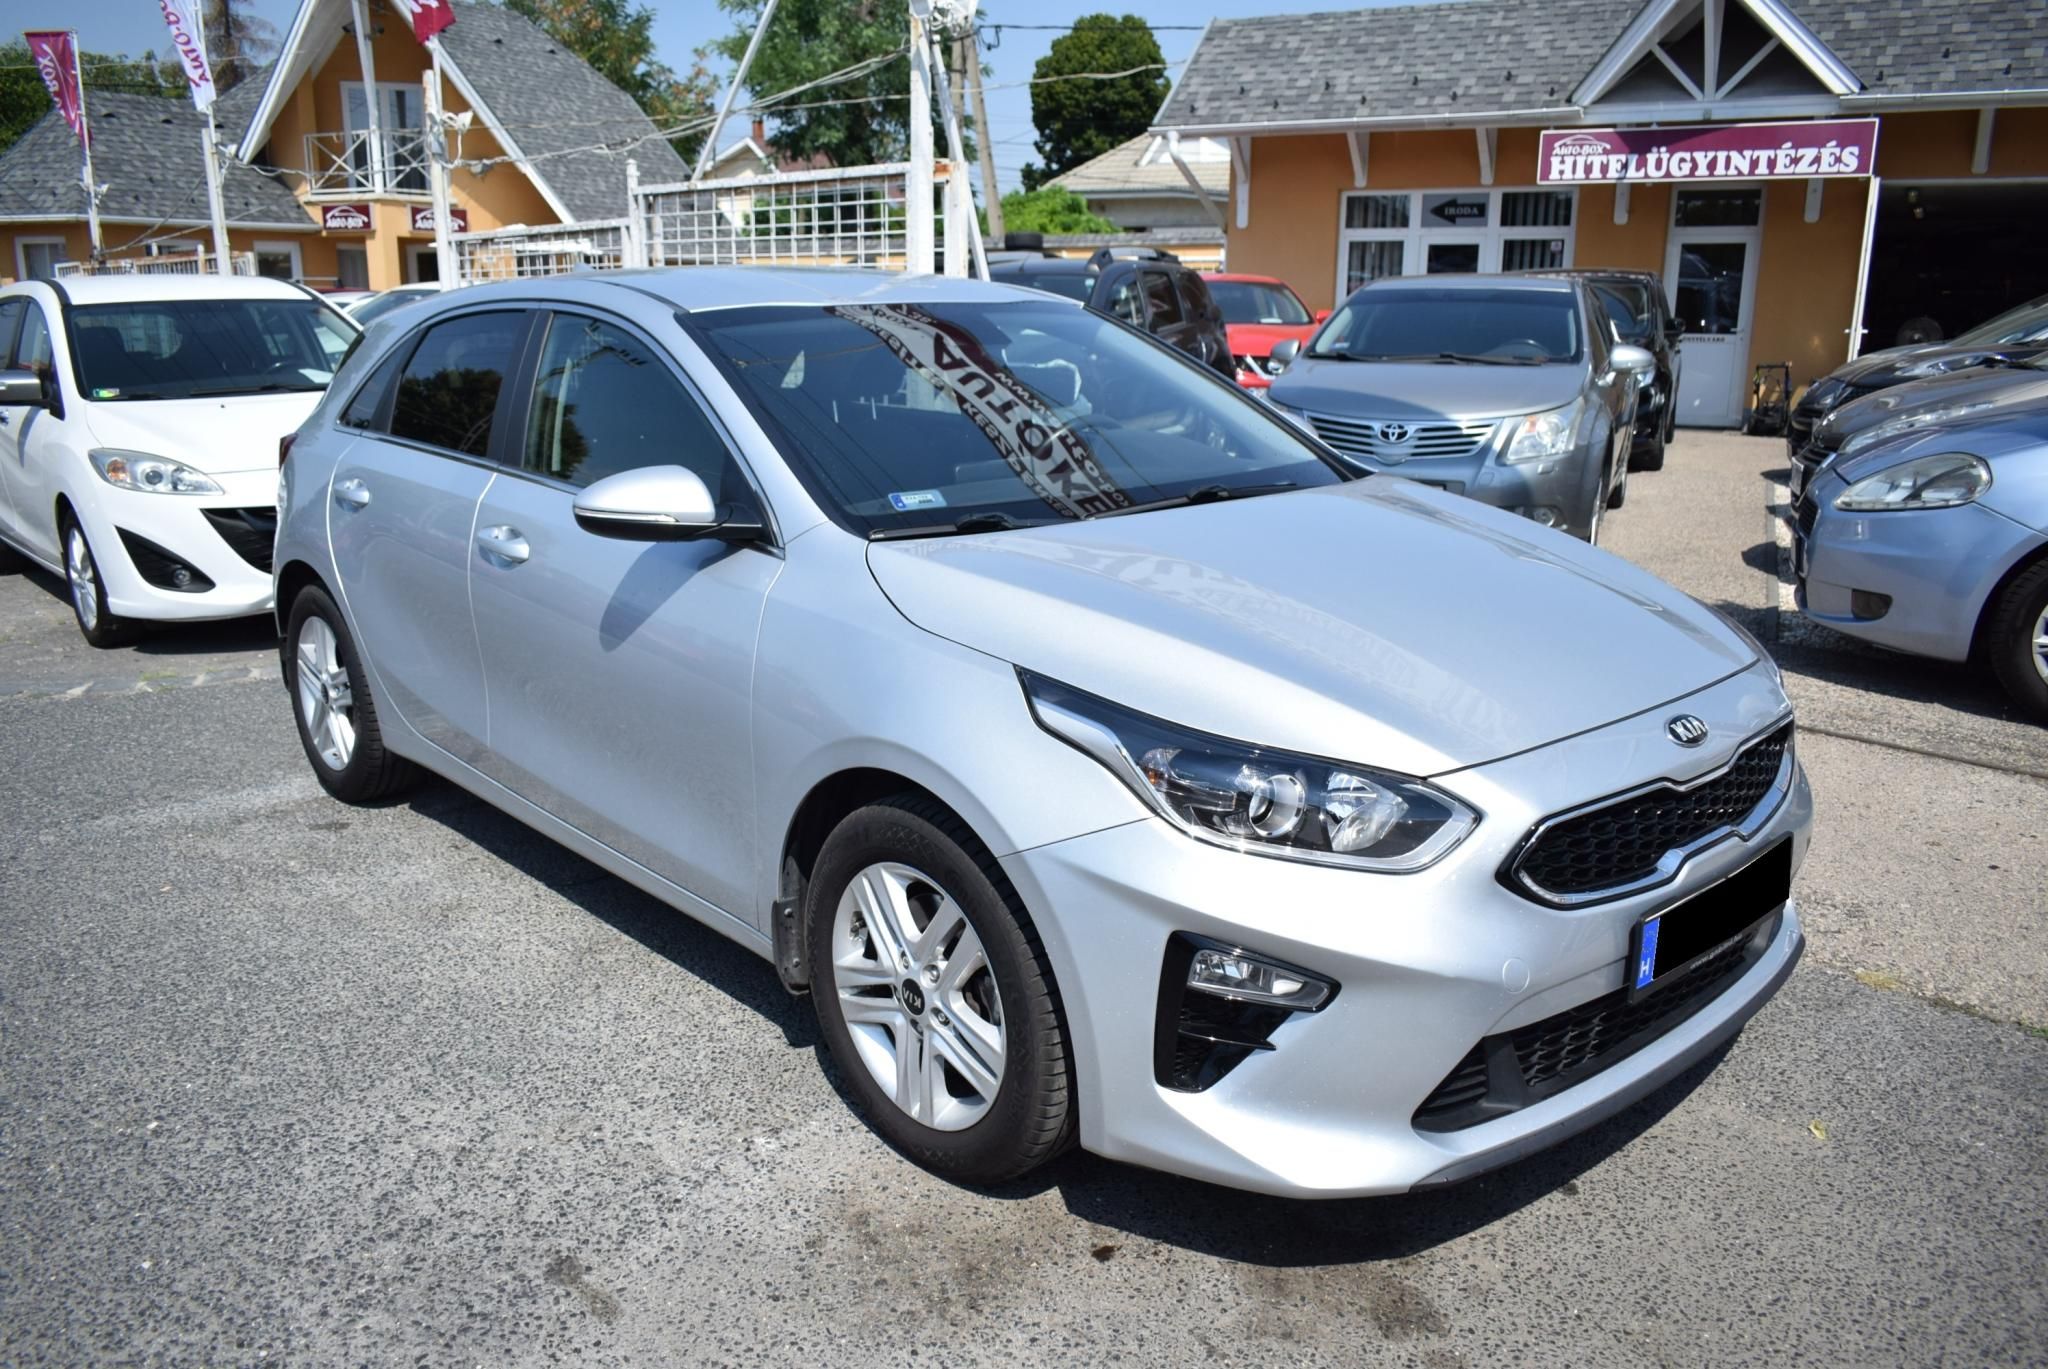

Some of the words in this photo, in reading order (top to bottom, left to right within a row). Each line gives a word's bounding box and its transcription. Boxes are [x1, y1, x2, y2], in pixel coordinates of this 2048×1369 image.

[1548, 140, 1860, 180] HITELÜGYINTÉZÉS
[1552, 144, 1604, 156] AUTO-BOX
[1444, 206, 1479, 216] IRODA
[1670, 716, 1706, 741] KIA
[1639, 957, 1651, 978] H
[903, 987, 922, 1008] KIA
